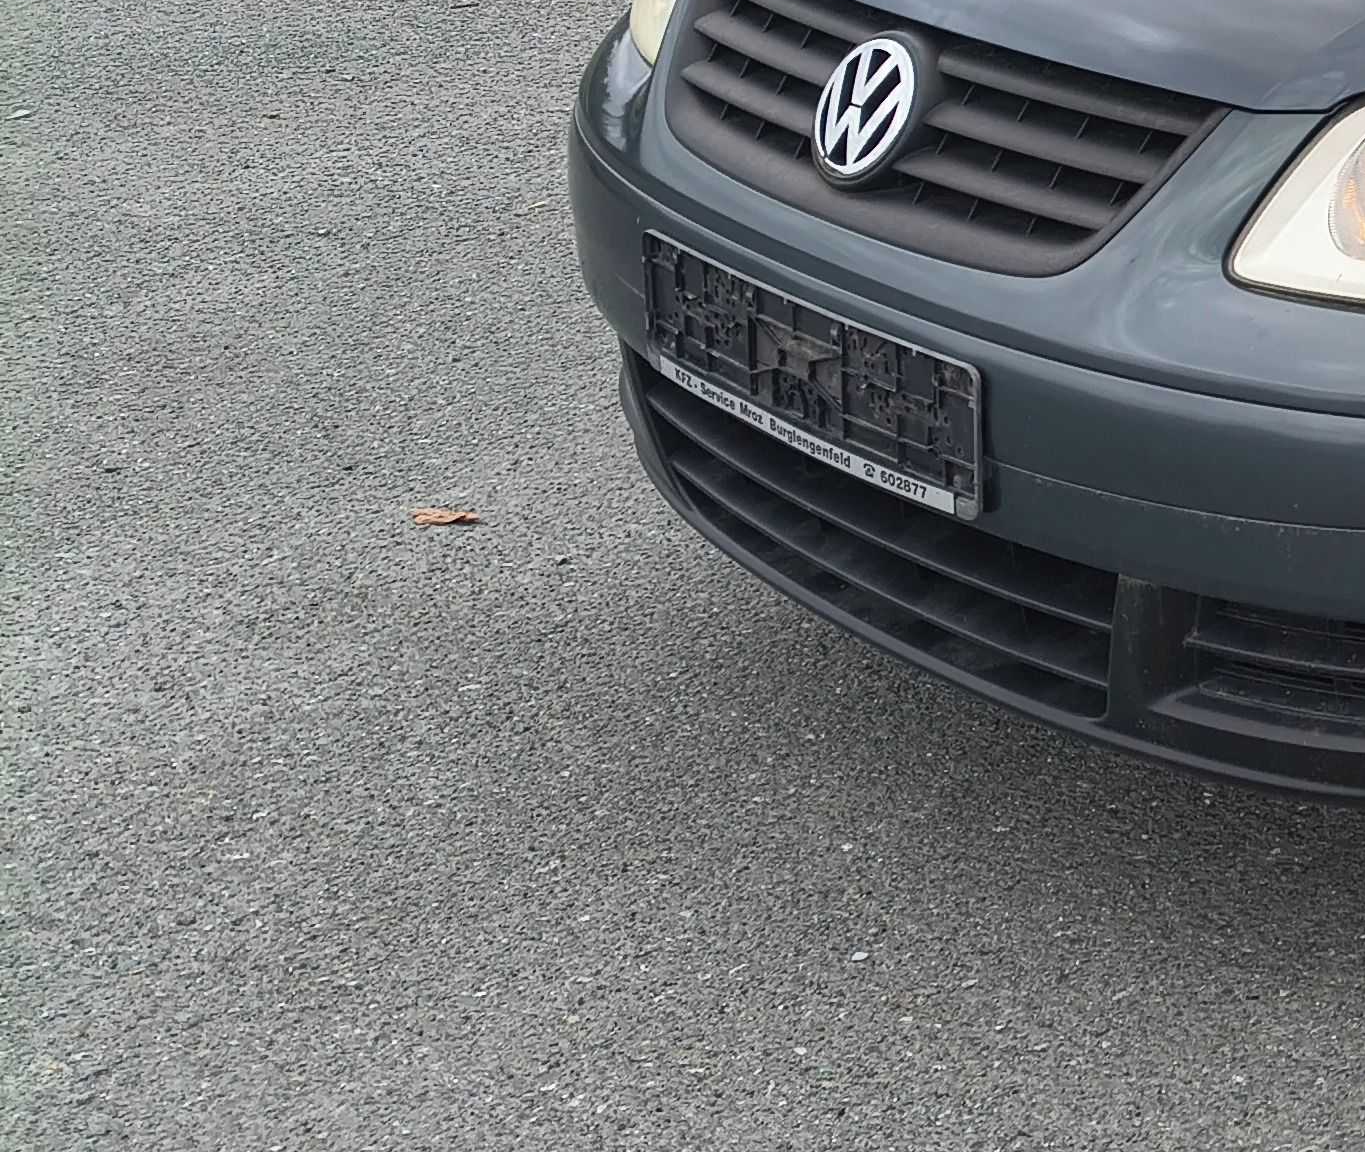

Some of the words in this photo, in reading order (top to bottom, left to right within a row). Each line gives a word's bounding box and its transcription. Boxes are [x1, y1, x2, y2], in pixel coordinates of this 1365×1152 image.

[815, 38, 915, 176] VW
[674, 367, 693, 388] KFZ
[700, 382, 736, 411] Service
[739, 402, 764, 425] Mroz
[769, 418, 851, 469] Burglengenfeld
[880, 470, 927, 499] 602877
